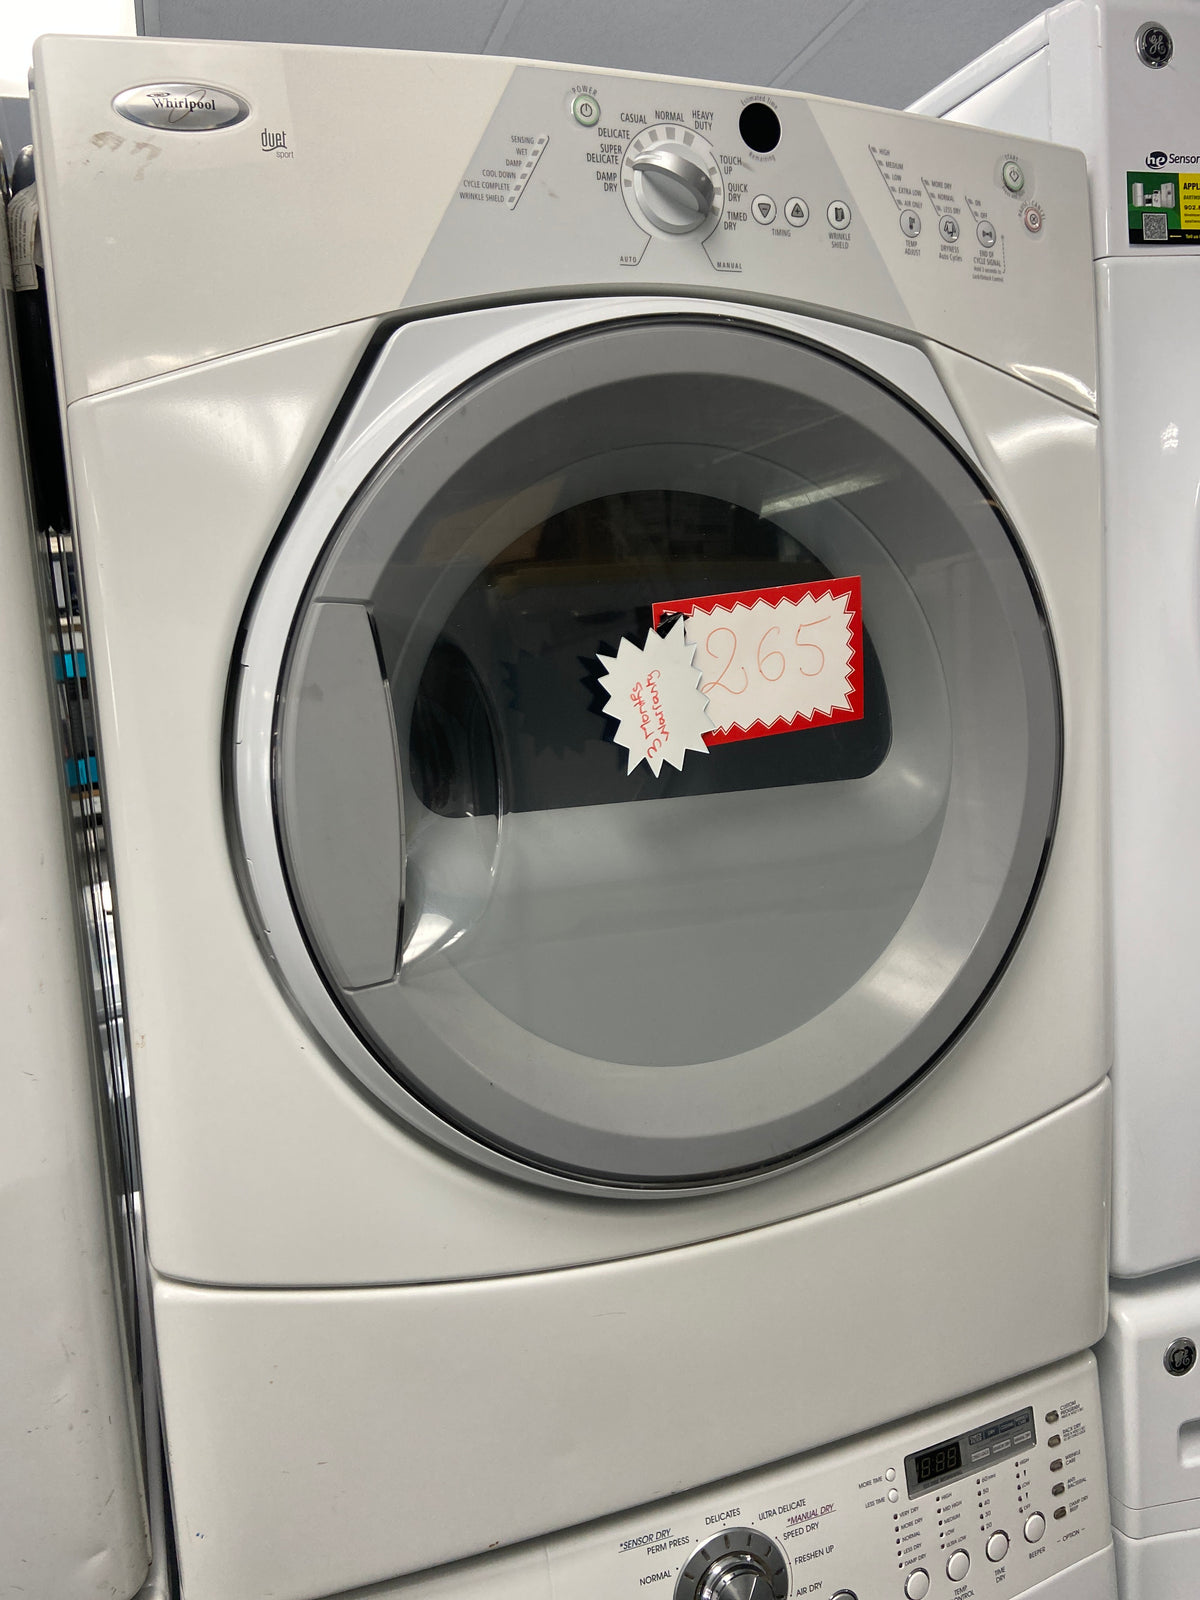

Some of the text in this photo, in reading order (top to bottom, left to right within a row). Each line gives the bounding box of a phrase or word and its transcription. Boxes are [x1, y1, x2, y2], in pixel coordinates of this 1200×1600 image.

[572, 85, 598, 96] POWER
[151, 97, 216, 112] Whirlpool
[620, 113, 647, 124] CASUAL
[655, 110, 684, 122] NORMAL
[692, 110, 714, 120] HEAVY
[694, 120, 713, 131] DUTY
[261, 128, 287, 148] duet
[598, 128, 630, 139] DELICATE
[511, 136, 534, 144] SENSING
[516, 148, 527, 156] WET
[600, 144, 622, 154] SUPER
[879, 148, 890, 156] HIGH
[276, 151, 294, 159] sport
[586, 153, 619, 164] DELICATE
[720, 155, 742, 165] TOUCH
[1169, 153, 1200, 164] Sensor
[505, 159, 522, 167] DAMP
[886, 161, 903, 170] MEDIUM
[482, 169, 516, 179] COOL DOWN
[724, 166, 733, 174] UP
[596, 171, 617, 181] DAMP
[463, 180, 510, 191] CYCLE COMPLETE
[603, 182, 618, 192] DRY
[728, 183, 748, 193] QUICK
[931, 180, 952, 190] MORE DRY
[898, 187, 922, 197] EXTRA LOW
[460, 192, 504, 203] WRINKLE SHIELD
[728, 193, 741, 202] DRY
[938, 193, 954, 202] NORMAL
[944, 206, 961, 215] LESS DRY
[727, 211, 747, 221] TIMED
[724, 221, 737, 230] DRY
[772, 228, 791, 237] TIMING
[828, 233, 851, 241] WRINKLE
[831, 241, 849, 249] SHIELD
[940, 244, 959, 254] DRYNESS
[904, 248, 920, 256] ADJUST
[717, 261, 742, 269] MANUAL
[973, 256, 986, 265] CYCLE
[700, 616, 831, 695] 265
[630, 681, 663, 758] 3 Months
[858, 1476, 883, 1489] MORE TIME
[1022, 1480, 1031, 1488] LOW
[941, 1493, 952, 1501] HIGH
[865, 1497, 885, 1509] LESS TIME
[952, 1501, 962, 1509] HIGH
[1023, 1503, 1031, 1511] OFF
[1069, 1498, 1081, 1508] DAMP
[758, 1498, 806, 1521] ULTRA DELICATE
[820, 1503, 834, 1514] DRY
[899, 1506, 919, 1518] VERY DRY
[705, 1508, 740, 1525] DELICATES
[944, 1513, 961, 1524] MEDIUM
[900, 1517, 923, 1530] MORE DRY
[655, 1528, 672, 1541] DRY
[783, 1521, 819, 1541] SPEED DRY
[945, 1528, 955, 1536] LOW
[1062, 1529, 1080, 1542] OPTION
[902, 1531, 920, 1542] NORMAL
[946, 1535, 967, 1548] ULTRA LOW
[647, 1536, 690, 1555] PERM PRESS
[903, 1543, 922, 1555] LESS DRY
[794, 1544, 835, 1565] FRESHEN UP
[1029, 1546, 1046, 1559] BEEPER
[904, 1557, 917, 1566] DAMP
[994, 1566, 1006, 1576] TIME
[639, 1570, 672, 1586] NORMAL
[995, 1575, 1006, 1583] DRY
[796, 1580, 823, 1597] AIR DRY
[954, 1584, 968, 1595] TEMP
